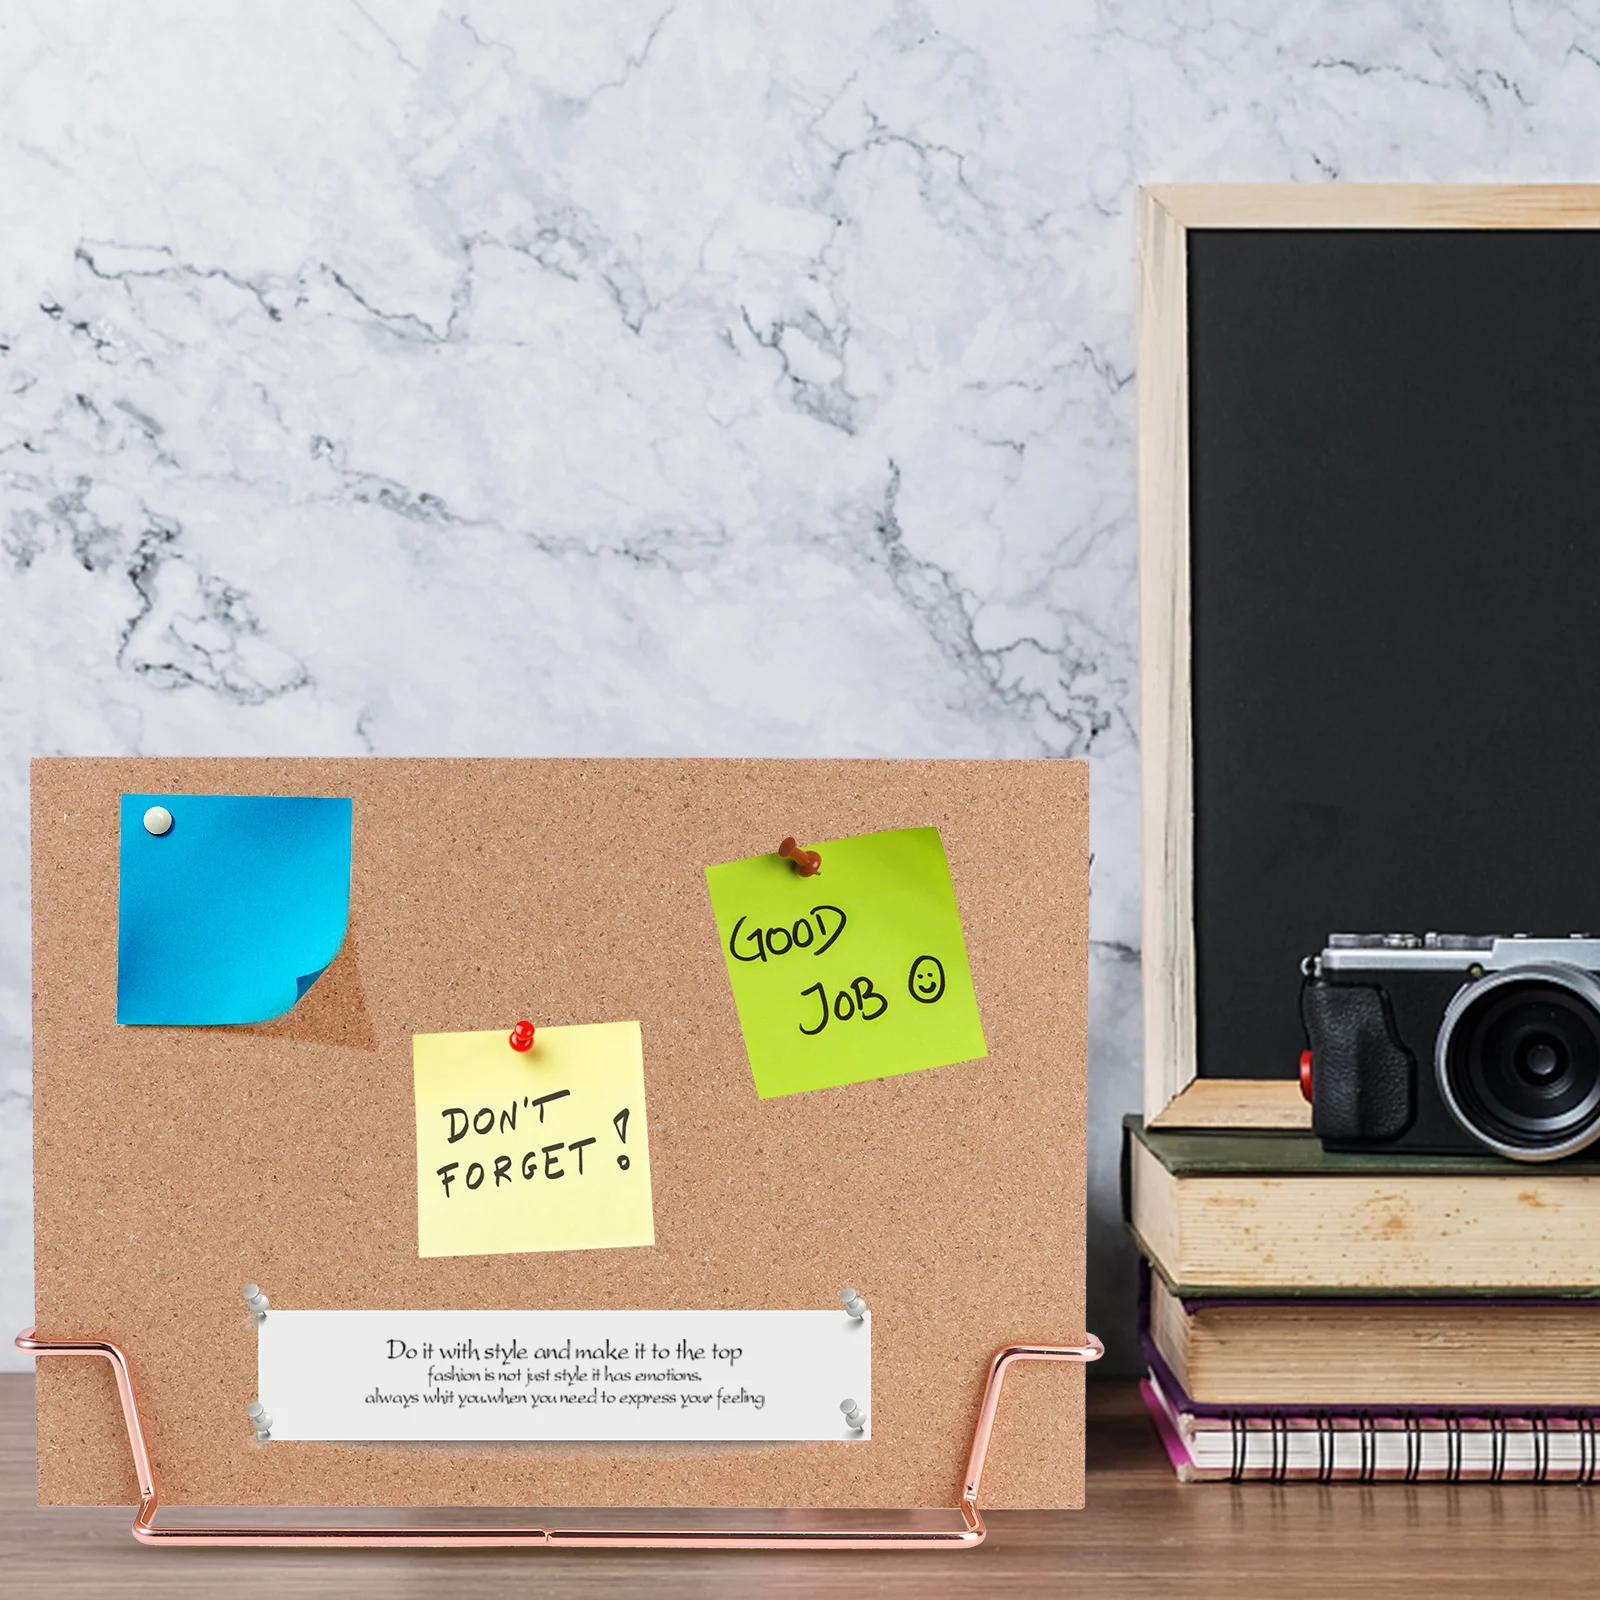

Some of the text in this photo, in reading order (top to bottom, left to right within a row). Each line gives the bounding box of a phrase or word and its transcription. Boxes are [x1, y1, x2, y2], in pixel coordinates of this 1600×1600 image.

[729, 905, 847, 962] GOOD
[799, 976, 888, 1036] JOB
[441, 1089, 571, 1144] DON'T
[436, 1137, 597, 1199] FORGET
[386, 1338, 743, 1367] Do it with style and make it to the top
[427, 1364, 703, 1387] fashion is not just style it has emotions.
[364, 1386, 420, 1409] always
[422, 1386, 455, 1405] whit
[531, 1394, 558, 1409] you
[559, 1386, 598, 1404] need
[600, 1390, 617, 1404] to
[618, 1393, 677, 1410] express
[680, 1393, 713, 1409] your
[716, 1386, 766, 1411] feeling
